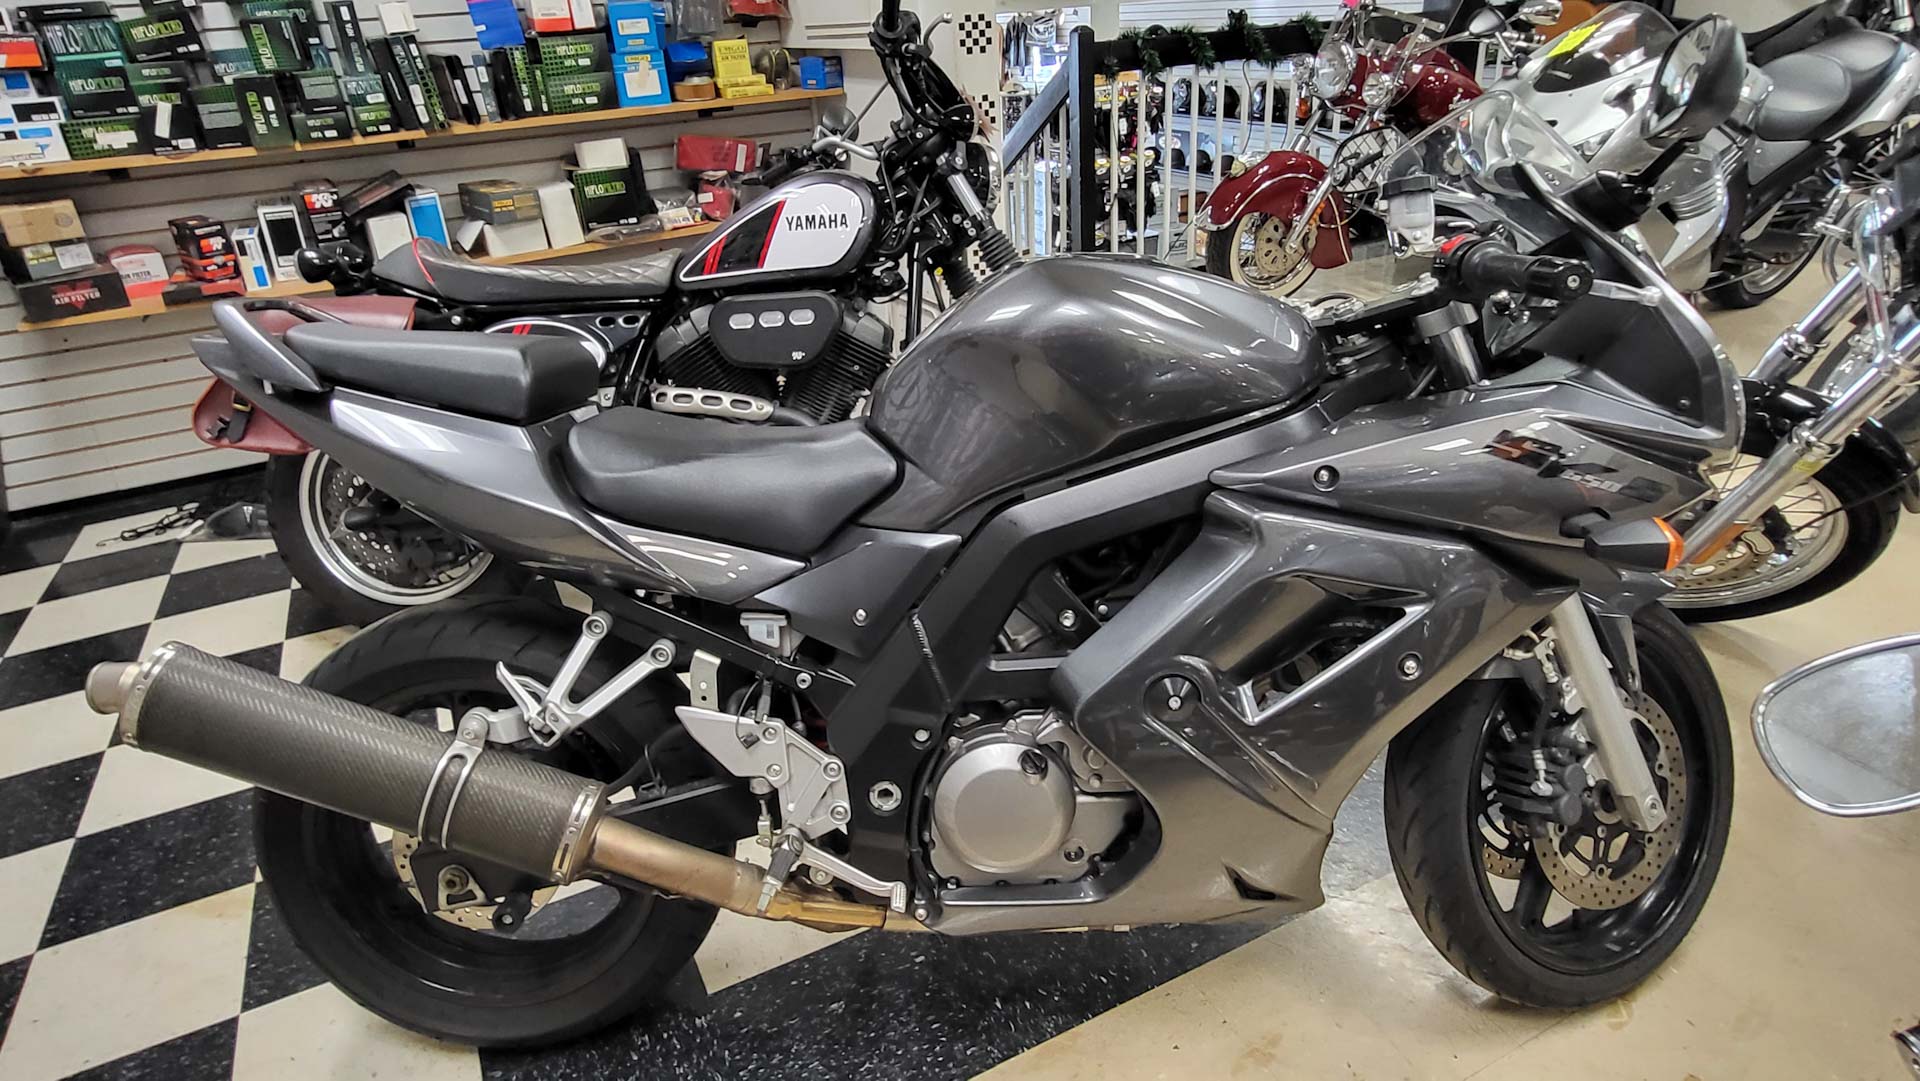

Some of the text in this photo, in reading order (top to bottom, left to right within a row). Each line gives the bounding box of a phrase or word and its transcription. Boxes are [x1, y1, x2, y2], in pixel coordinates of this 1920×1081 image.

[43, 20, 118, 54] HIFLOFILTRO
[130, 19, 185, 40] HIFLOFILTRO
[69, 76, 126, 95] HIFLOFILTRO
[583, 181, 626, 199] HIFLOFILTRO
[785, 213, 849, 231] YAMAHA
